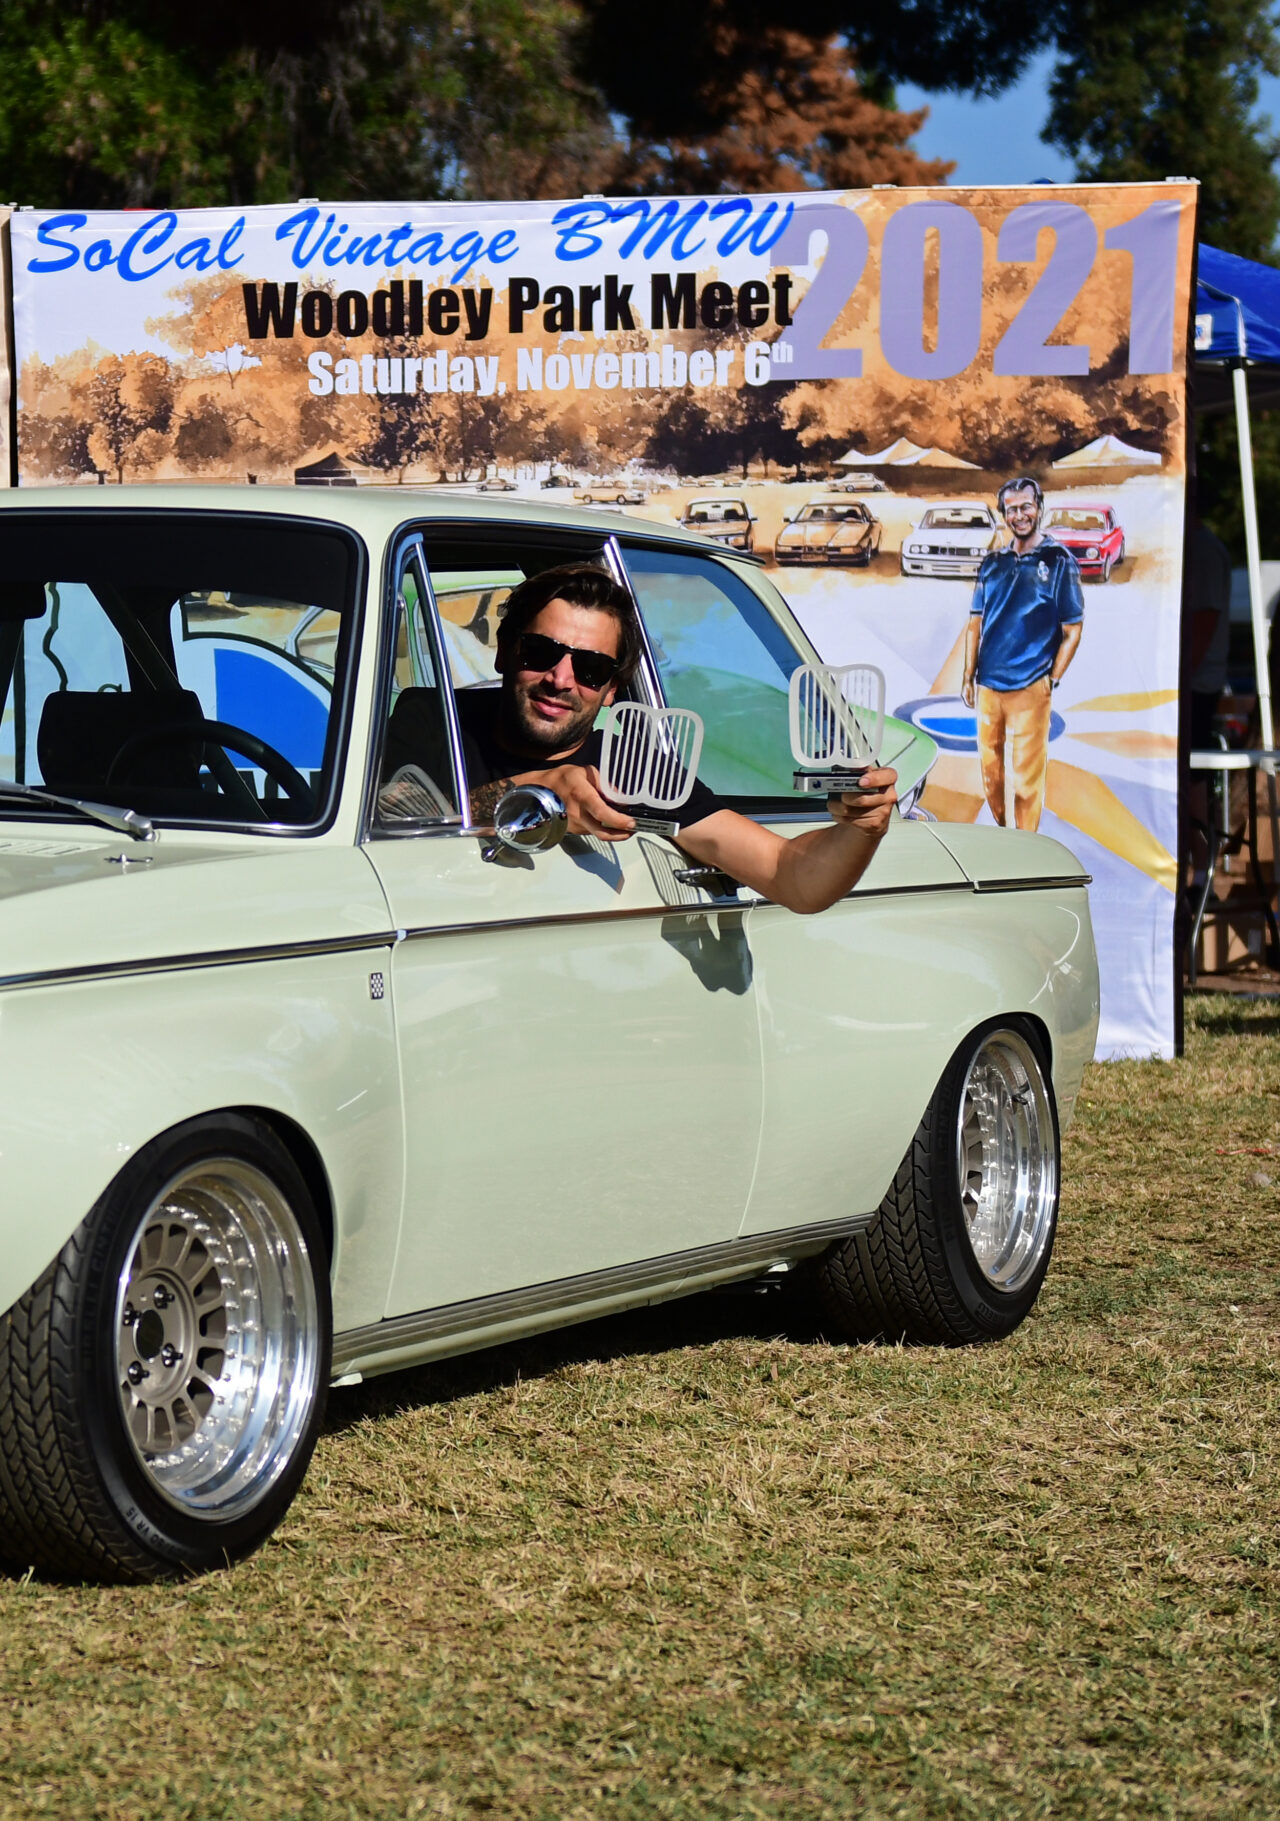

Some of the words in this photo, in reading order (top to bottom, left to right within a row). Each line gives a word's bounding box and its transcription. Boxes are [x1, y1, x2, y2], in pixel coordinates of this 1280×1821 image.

[26, 211, 246, 282] SoCal
[275, 206, 519, 285] Vintage
[551, 198, 795, 262] BMW
[242, 278, 494, 341] Woodley
[508, 274, 636, 334] Park
[650, 272, 794, 330] Meet
[769, 200, 1182, 381] 2021
[307, 349, 507, 397] Saturday,
[516, 344, 735, 391] November
